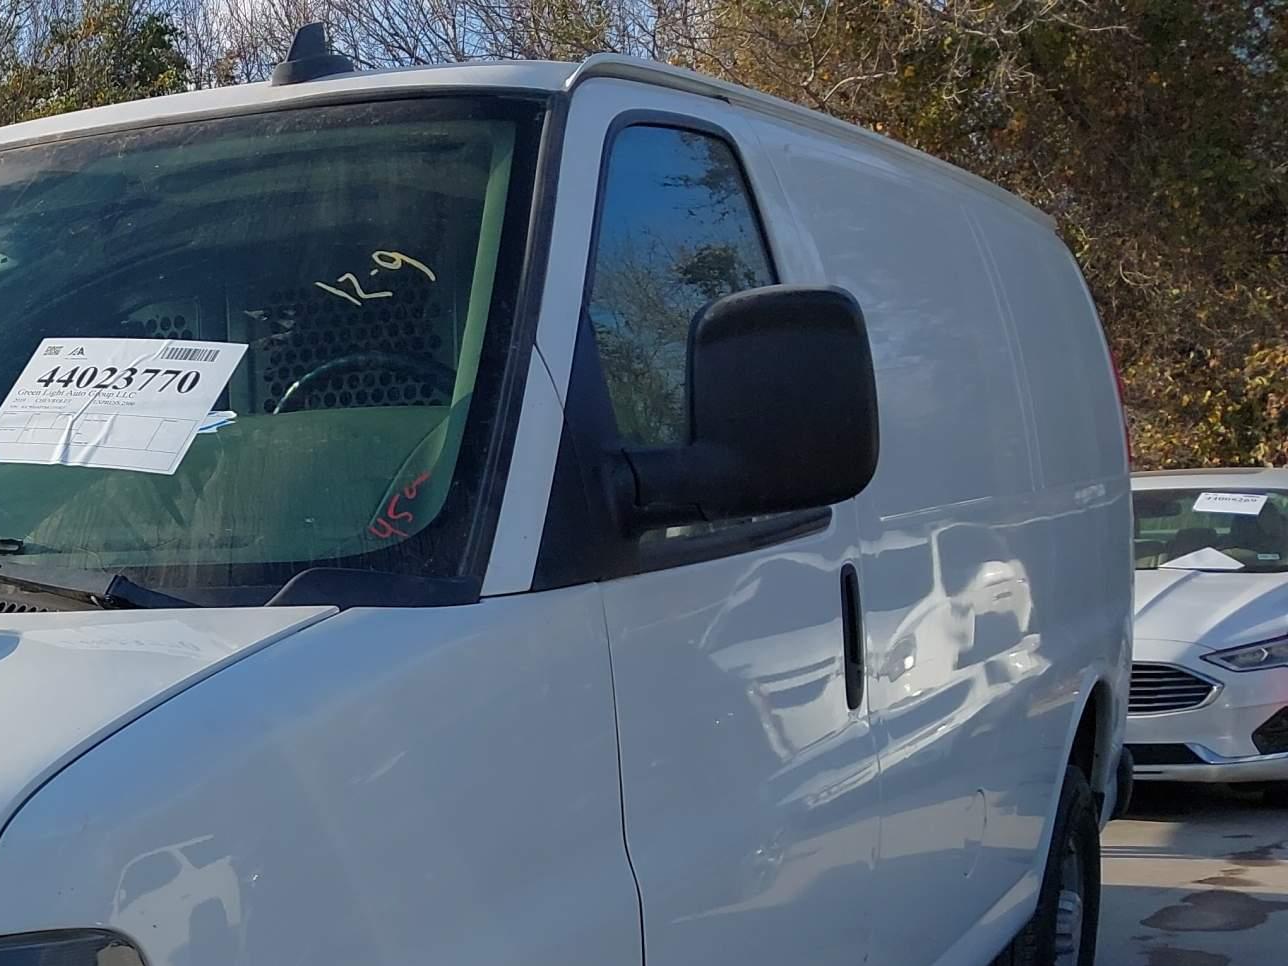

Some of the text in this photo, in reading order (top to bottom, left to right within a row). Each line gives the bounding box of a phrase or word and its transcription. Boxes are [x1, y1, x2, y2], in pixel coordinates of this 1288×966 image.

[37, 366, 201, 394] 44023770
[17, 388, 41, 396] Green
[43, 389, 64, 398] Light
